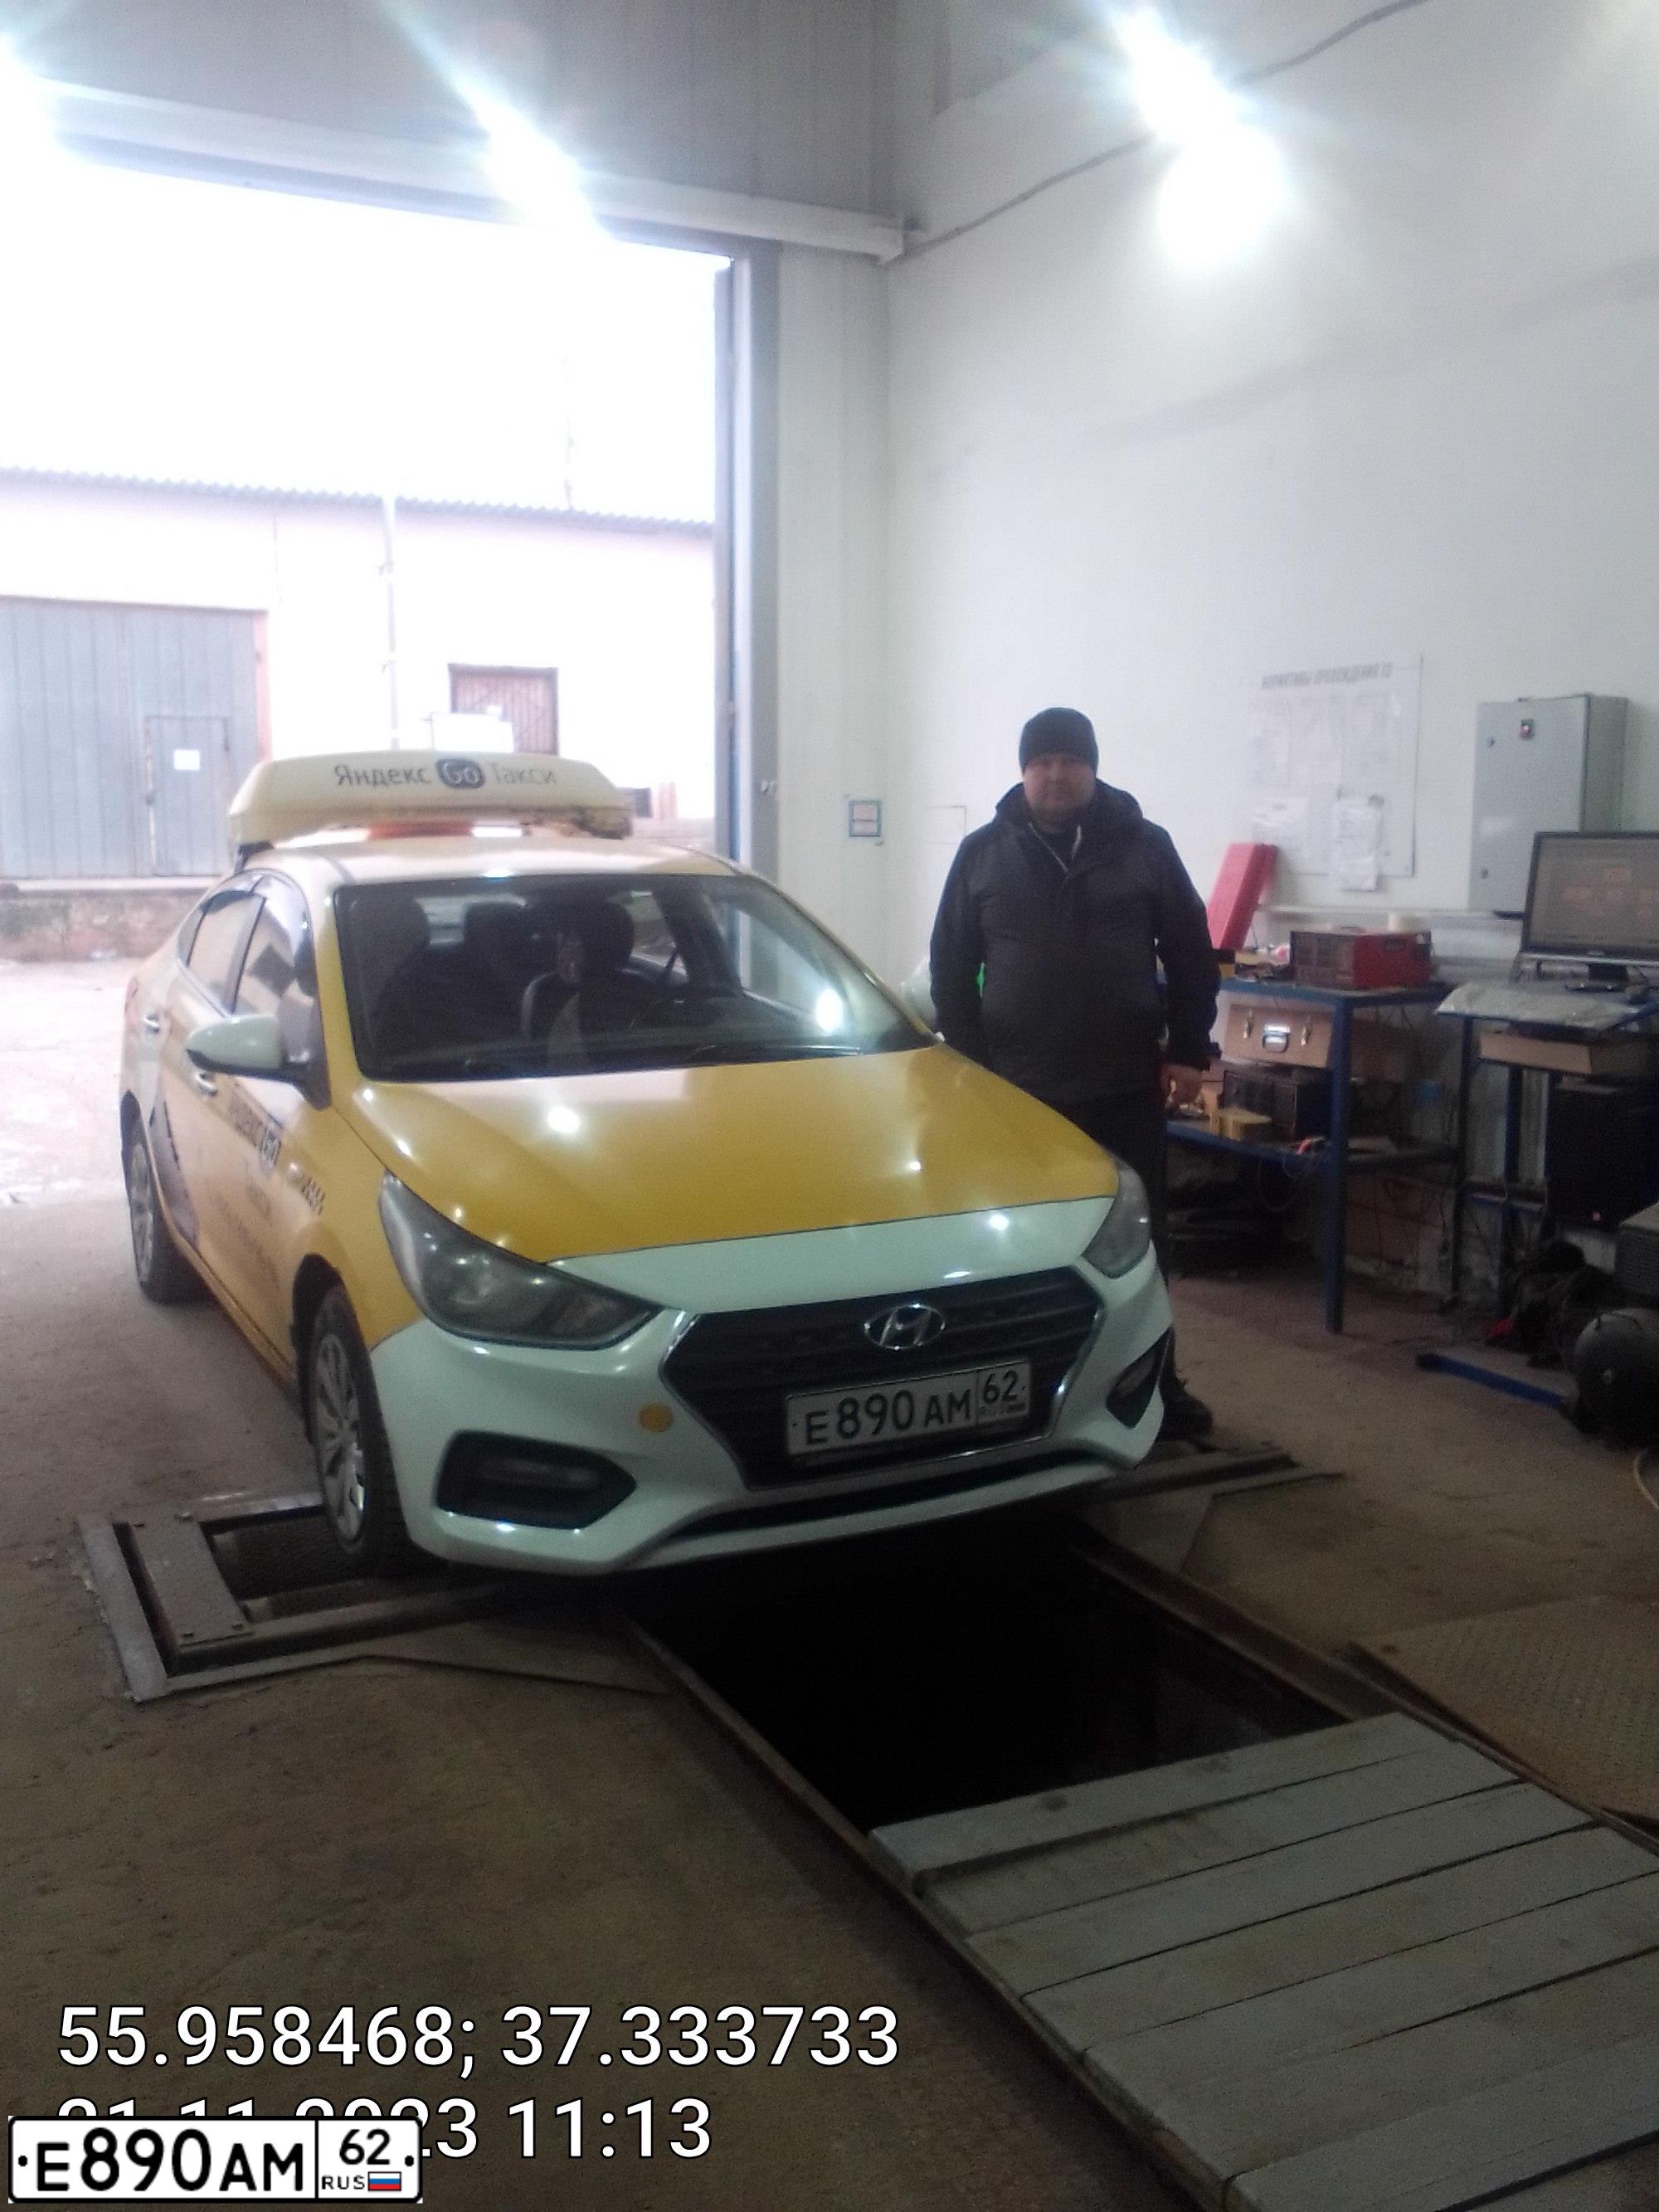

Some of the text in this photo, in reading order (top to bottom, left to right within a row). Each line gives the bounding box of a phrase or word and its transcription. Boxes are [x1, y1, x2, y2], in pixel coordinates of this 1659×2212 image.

[334, 764, 431, 787] Яндекс
[490, 763, 557, 784] Такси
[982, 1370, 1018, 1404] 62
